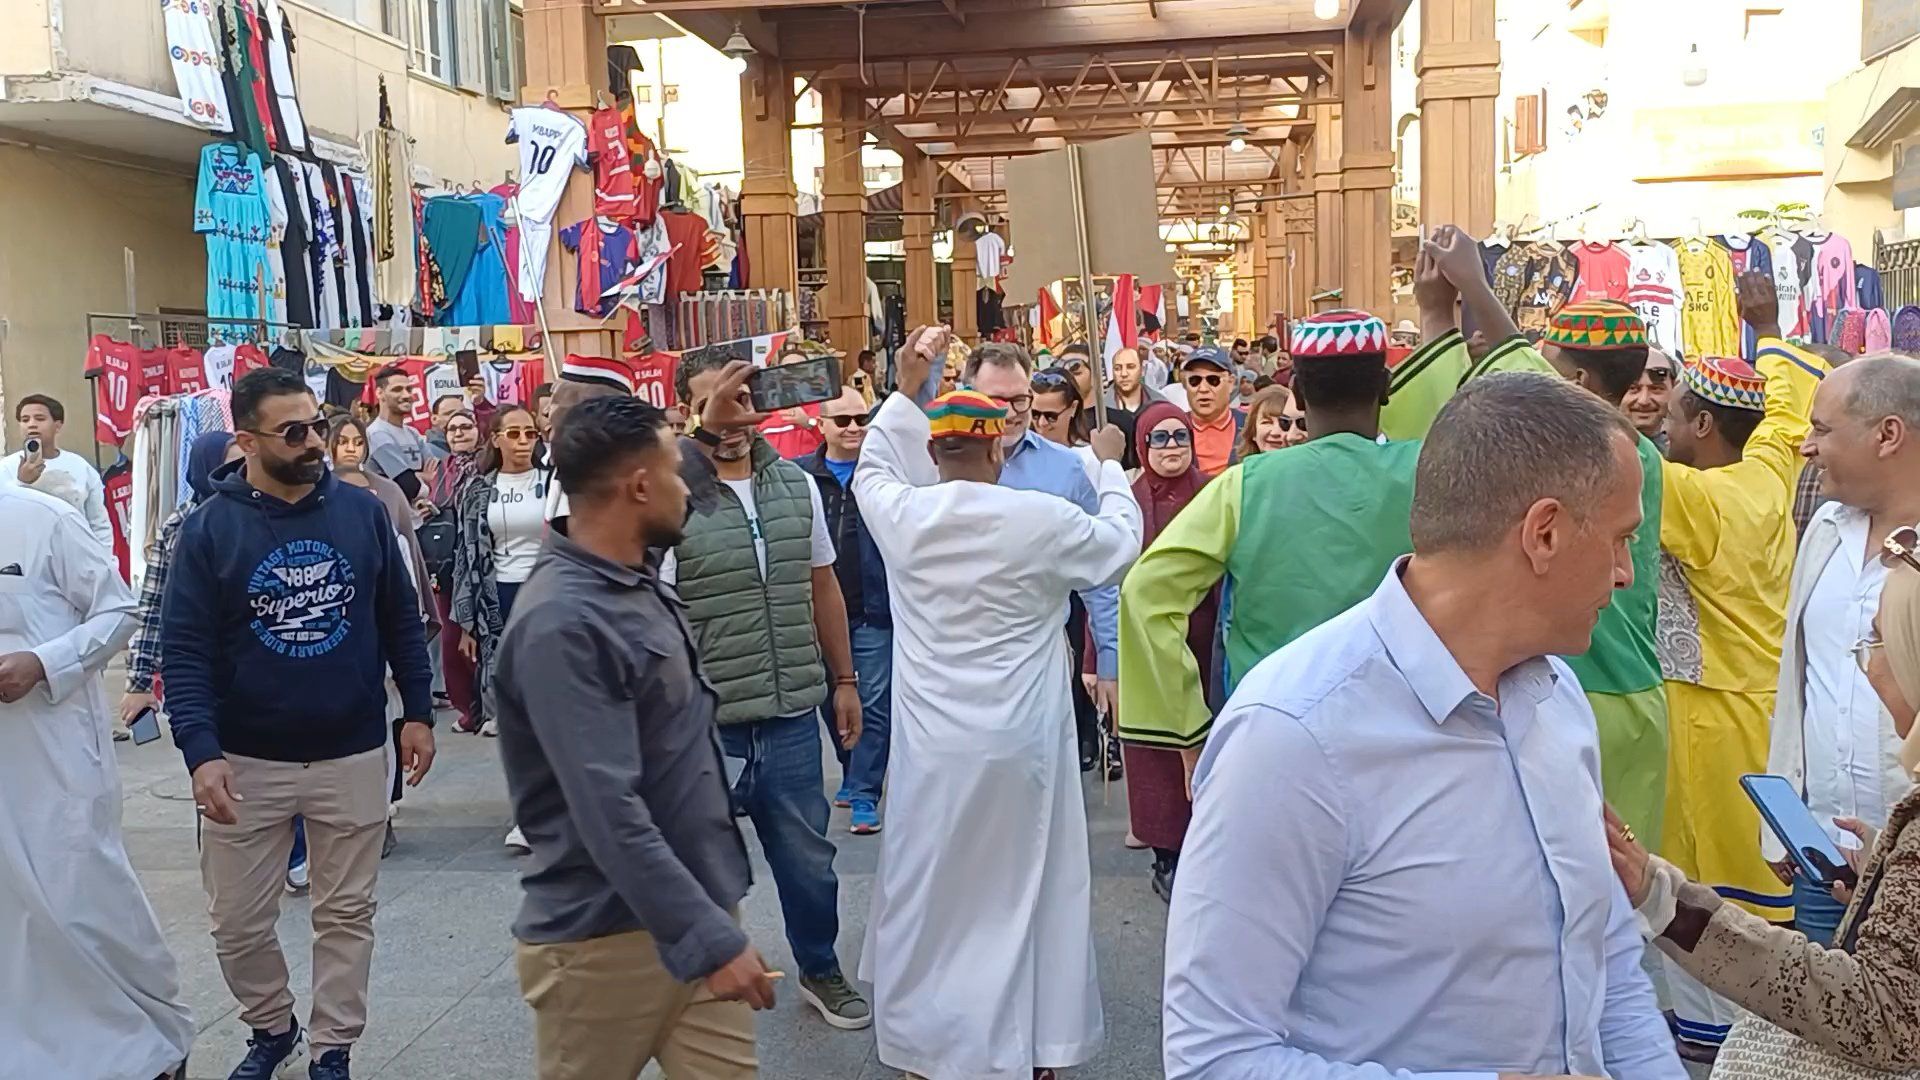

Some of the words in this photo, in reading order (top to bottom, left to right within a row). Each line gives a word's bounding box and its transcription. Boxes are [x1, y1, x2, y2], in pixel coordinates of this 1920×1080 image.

[532, 124, 563, 139] MBAPP
[529, 140, 556, 174] 10
[107, 371, 128, 412] 10
[434, 379, 460, 389] RONAL
[501, 487, 524, 504] alo
[248, 548, 285, 594] VINTAGE
[289, 619, 351, 657] LEGENDARY
